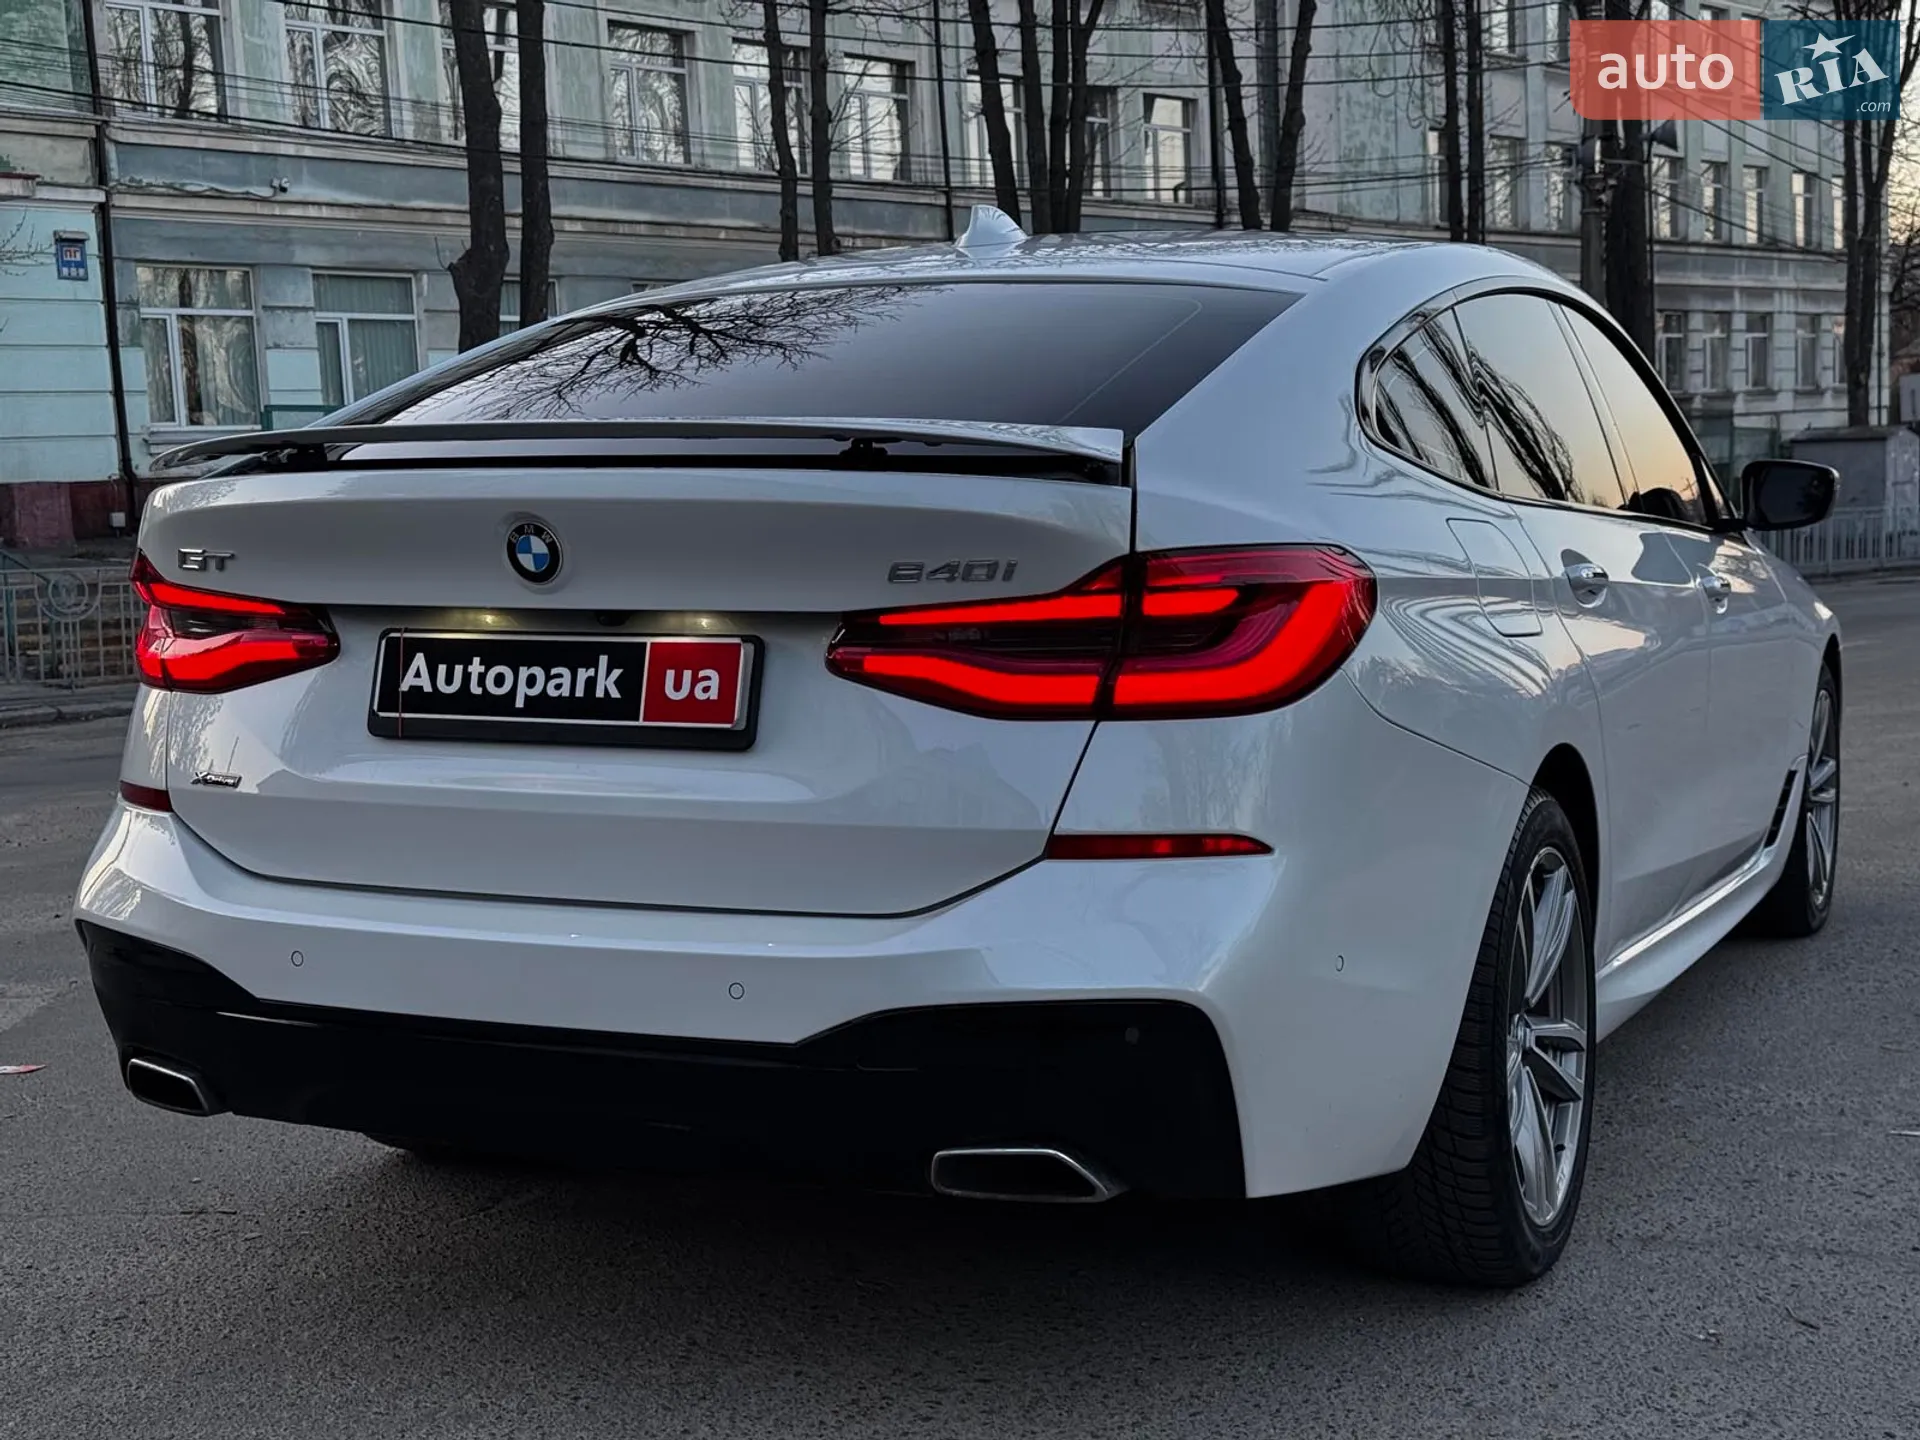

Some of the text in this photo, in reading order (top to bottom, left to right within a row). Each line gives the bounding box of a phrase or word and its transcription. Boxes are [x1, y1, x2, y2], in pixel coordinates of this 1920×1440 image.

[509, 524, 553, 543] BMW
[178, 548, 235, 571] GT
[400, 652, 720, 708] Autopark ua
